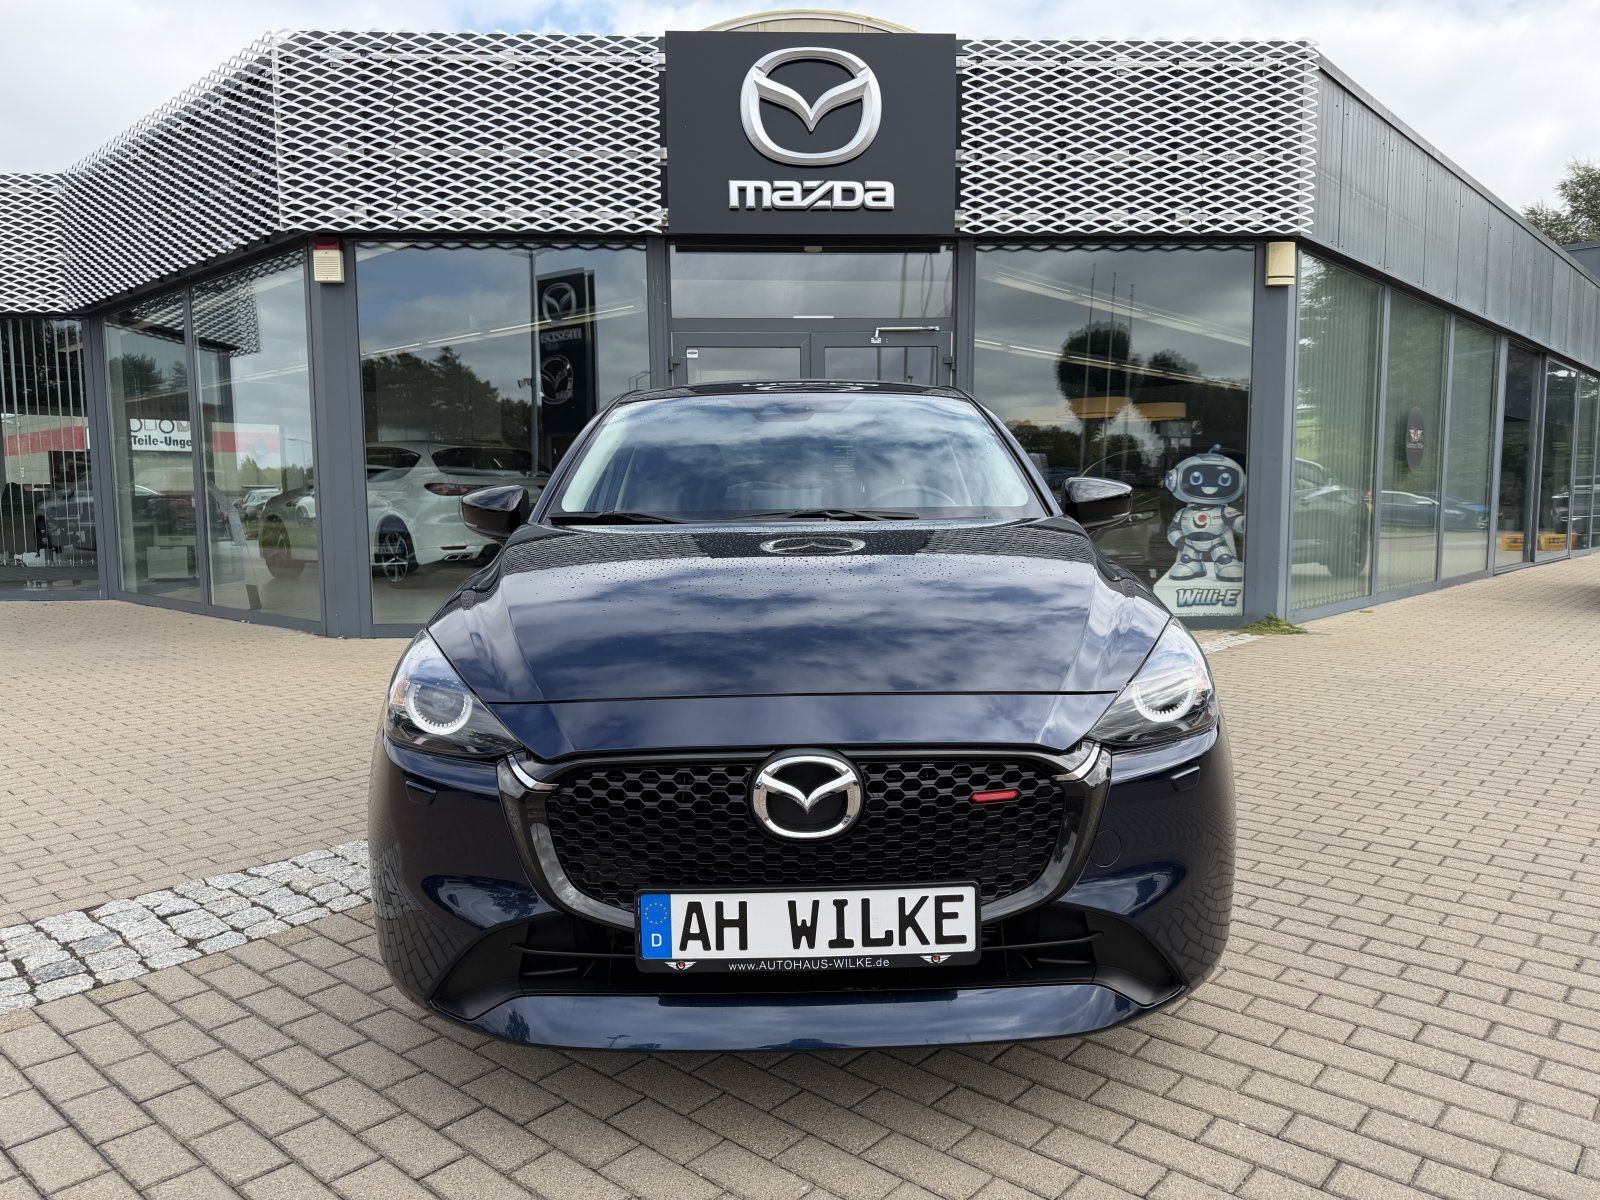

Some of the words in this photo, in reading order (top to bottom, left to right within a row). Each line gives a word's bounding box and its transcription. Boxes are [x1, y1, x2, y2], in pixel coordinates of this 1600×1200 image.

[1176, 588, 1241, 607] Willi-E
[651, 933, 662, 947] D
[679, 900, 748, 951] AH
[787, 894, 967, 949] WILKE
[728, 957, 890, 970] www.AUTOHAUS-WILKE.de
